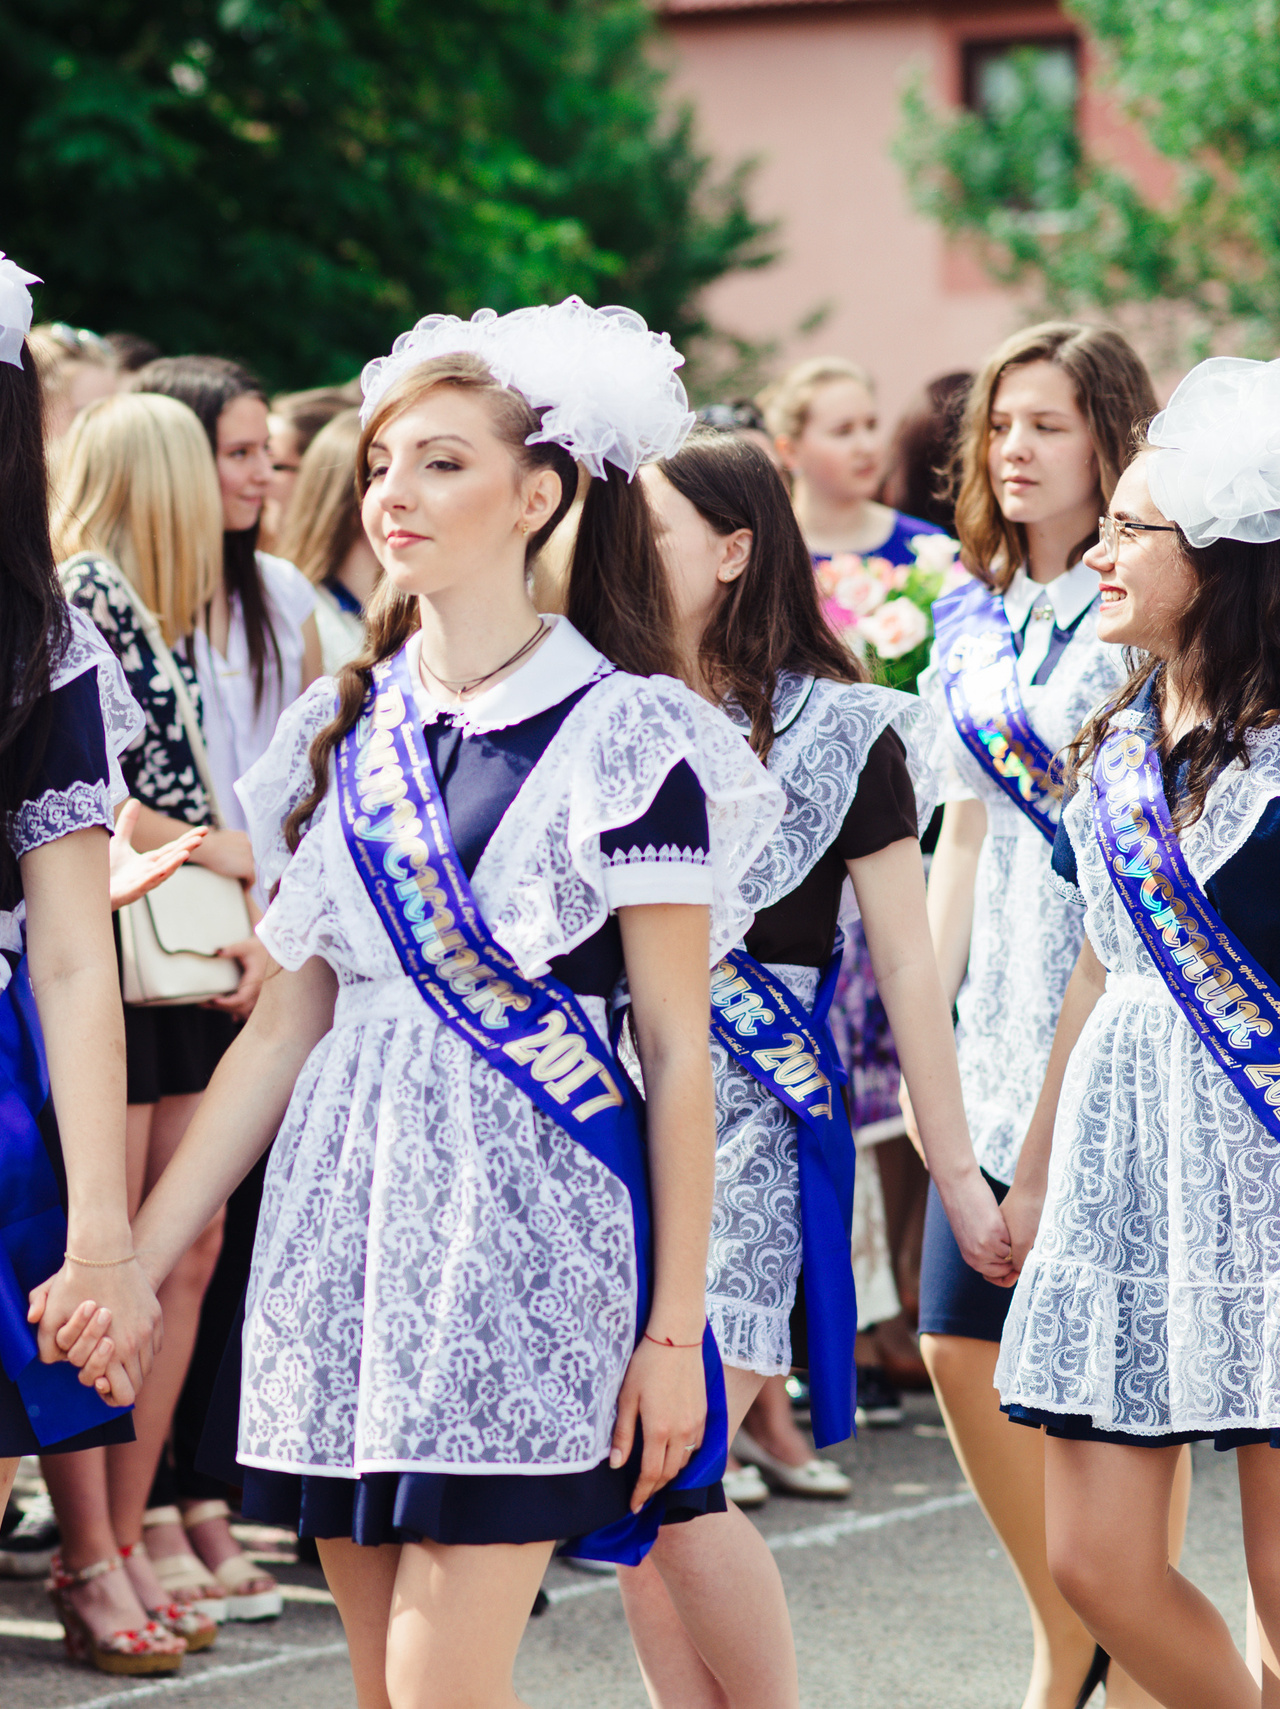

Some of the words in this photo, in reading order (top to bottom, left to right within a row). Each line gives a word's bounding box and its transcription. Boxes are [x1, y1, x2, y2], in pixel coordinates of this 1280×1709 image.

[1101, 733, 1273, 1049] Випускник
[502, 1010, 624, 1123] 2017
[751, 1033, 833, 1121] 2017
